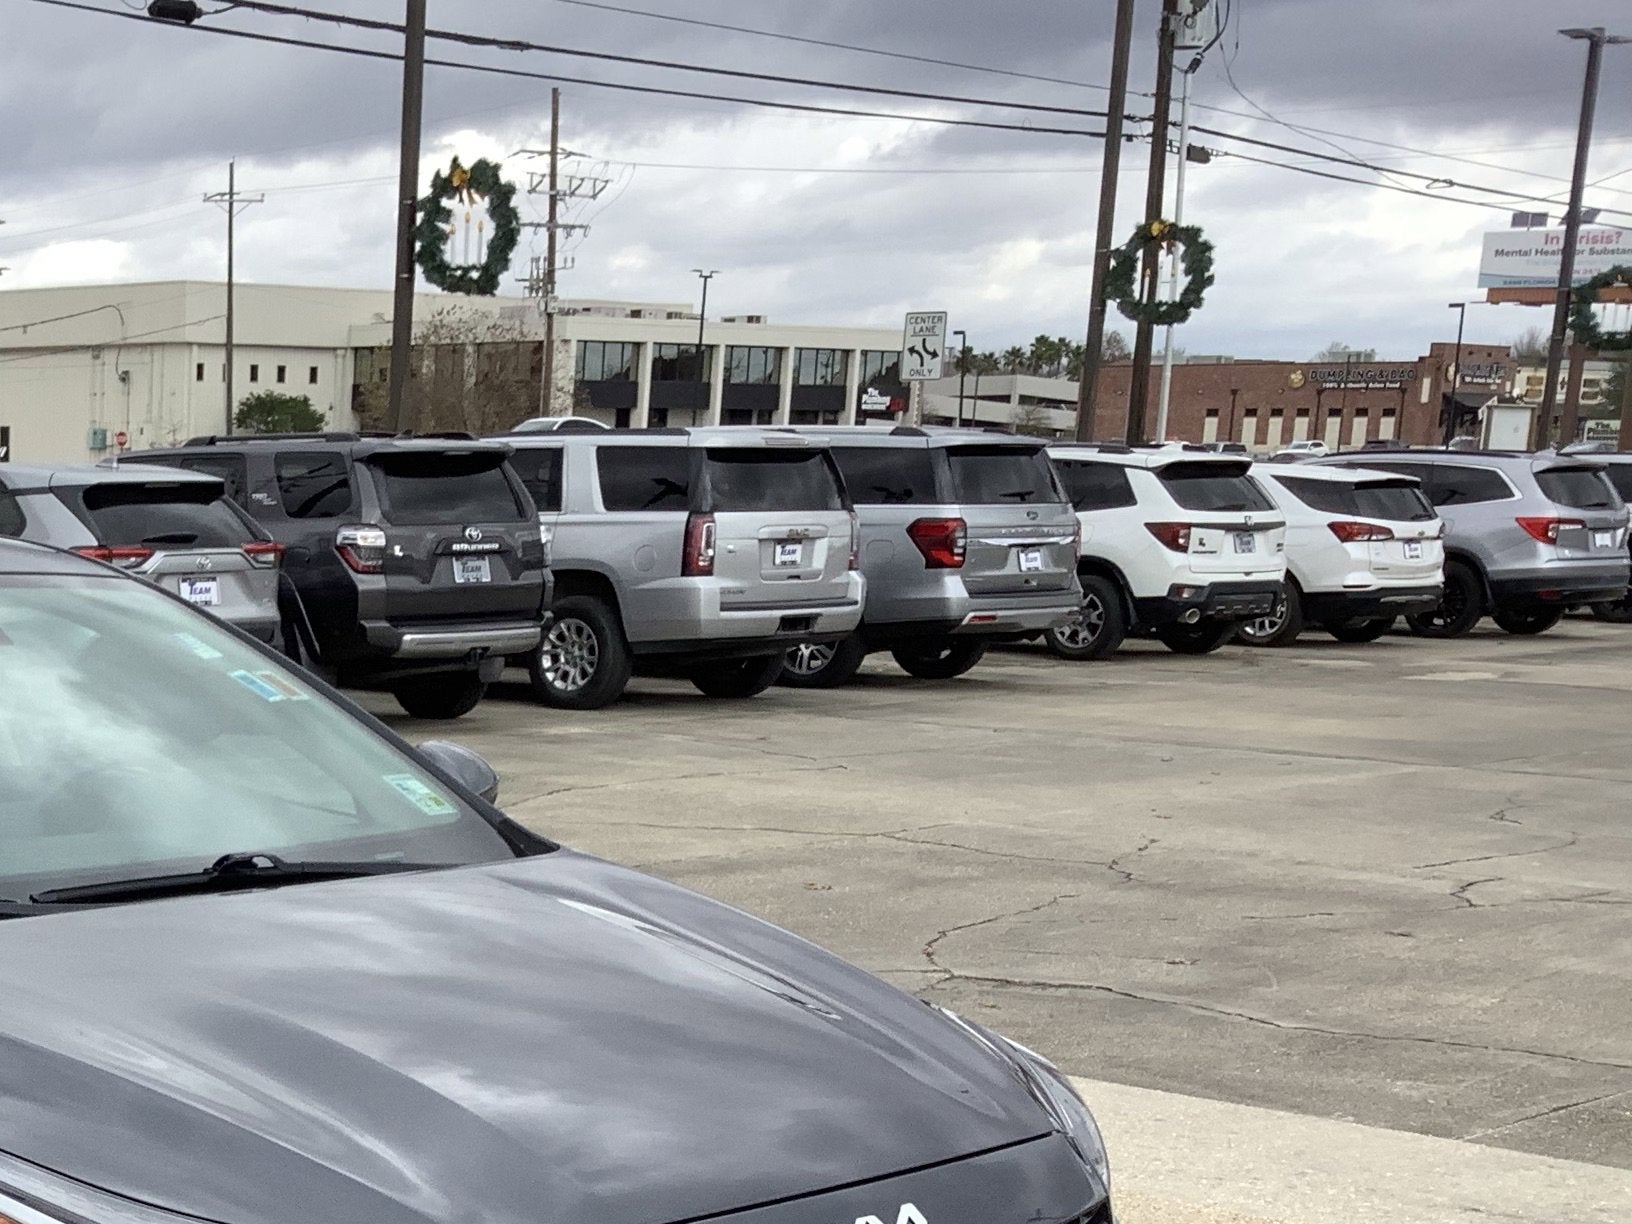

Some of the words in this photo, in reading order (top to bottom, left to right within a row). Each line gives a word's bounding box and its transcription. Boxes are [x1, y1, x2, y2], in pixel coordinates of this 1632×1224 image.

[1544, 232, 1560, 246] In
[1578, 230, 1623, 245] risis?
[1494, 248, 1532, 258] Mental
[909, 315, 943, 325] CENTER
[913, 325, 937, 335] LANE
[909, 368, 933, 377] ONLY
[1310, 369, 1375, 380] DUMPING
[1390, 368, 1416, 379] BAO
[188, 579, 212, 595] TEAM
